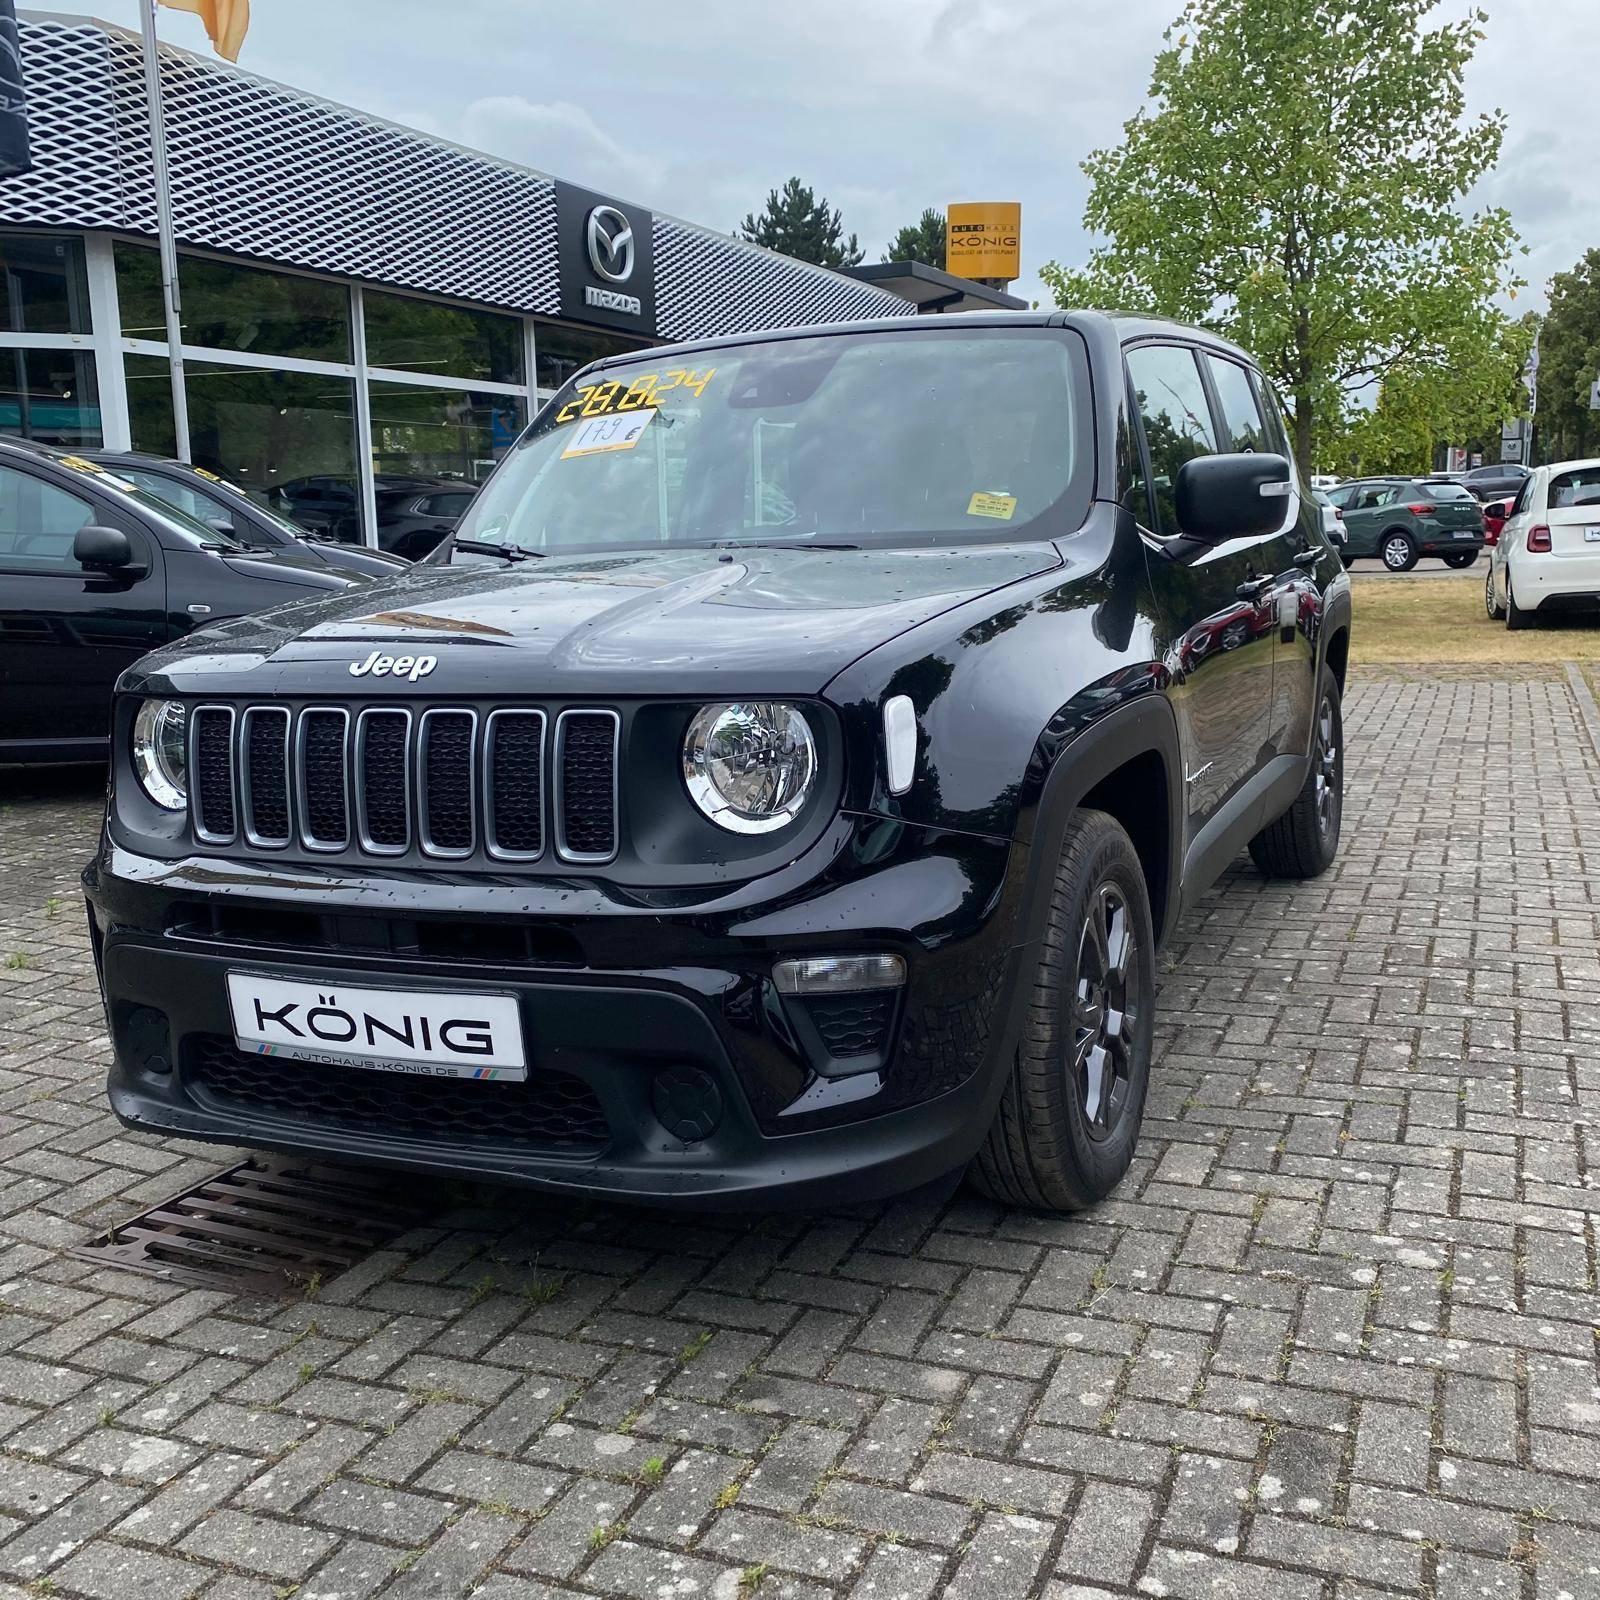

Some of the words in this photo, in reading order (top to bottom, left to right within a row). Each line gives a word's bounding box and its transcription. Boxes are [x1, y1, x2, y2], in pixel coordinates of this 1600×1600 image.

[951, 234, 1017, 247] KÖNIG
[585, 285, 641, 315] mazda
[555, 368, 717, 423] 28.824
[577, 417, 623, 446] 179
[349, 651, 438, 682] Jeep
[253, 993, 494, 1056] KÖNIG
[291, 1051, 459, 1077] AUTOHAUS-KÖNIG.DE
